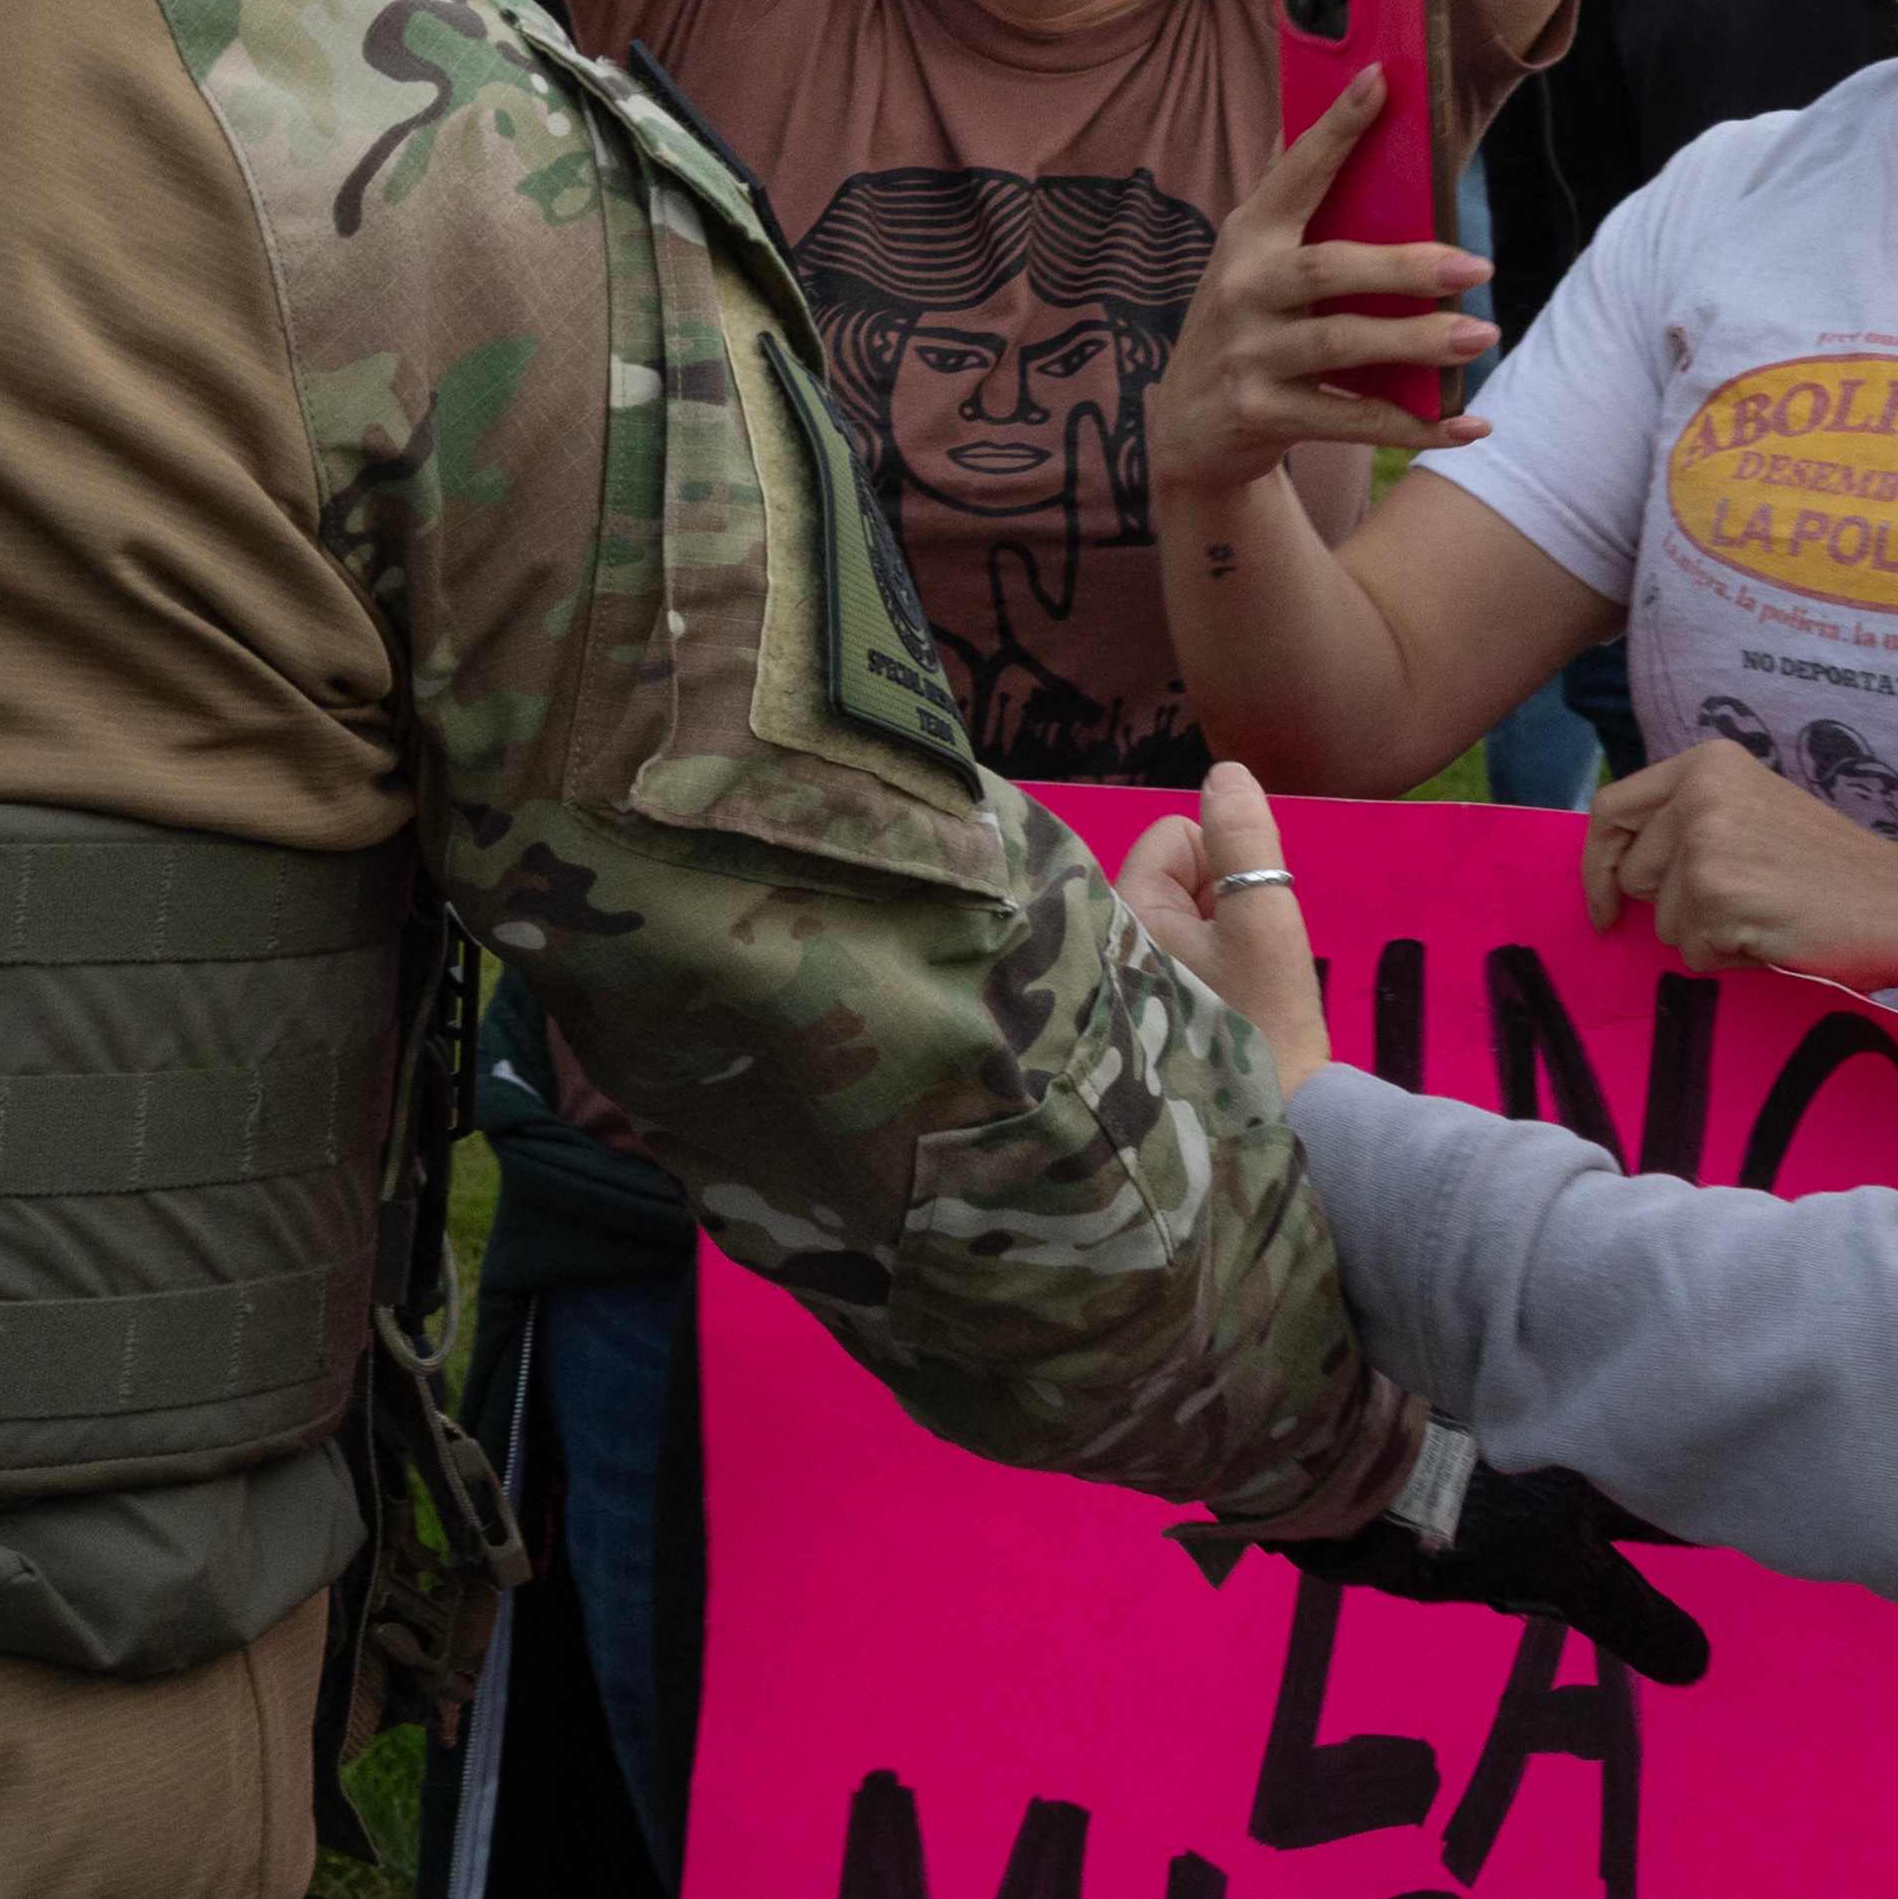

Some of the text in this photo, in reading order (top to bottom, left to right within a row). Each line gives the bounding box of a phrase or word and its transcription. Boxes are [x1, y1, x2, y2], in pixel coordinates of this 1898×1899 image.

[1711, 498, 1775, 555] LA
[1740, 648, 1776, 674] NO
[1248, 1568, 1643, 1899] LA
